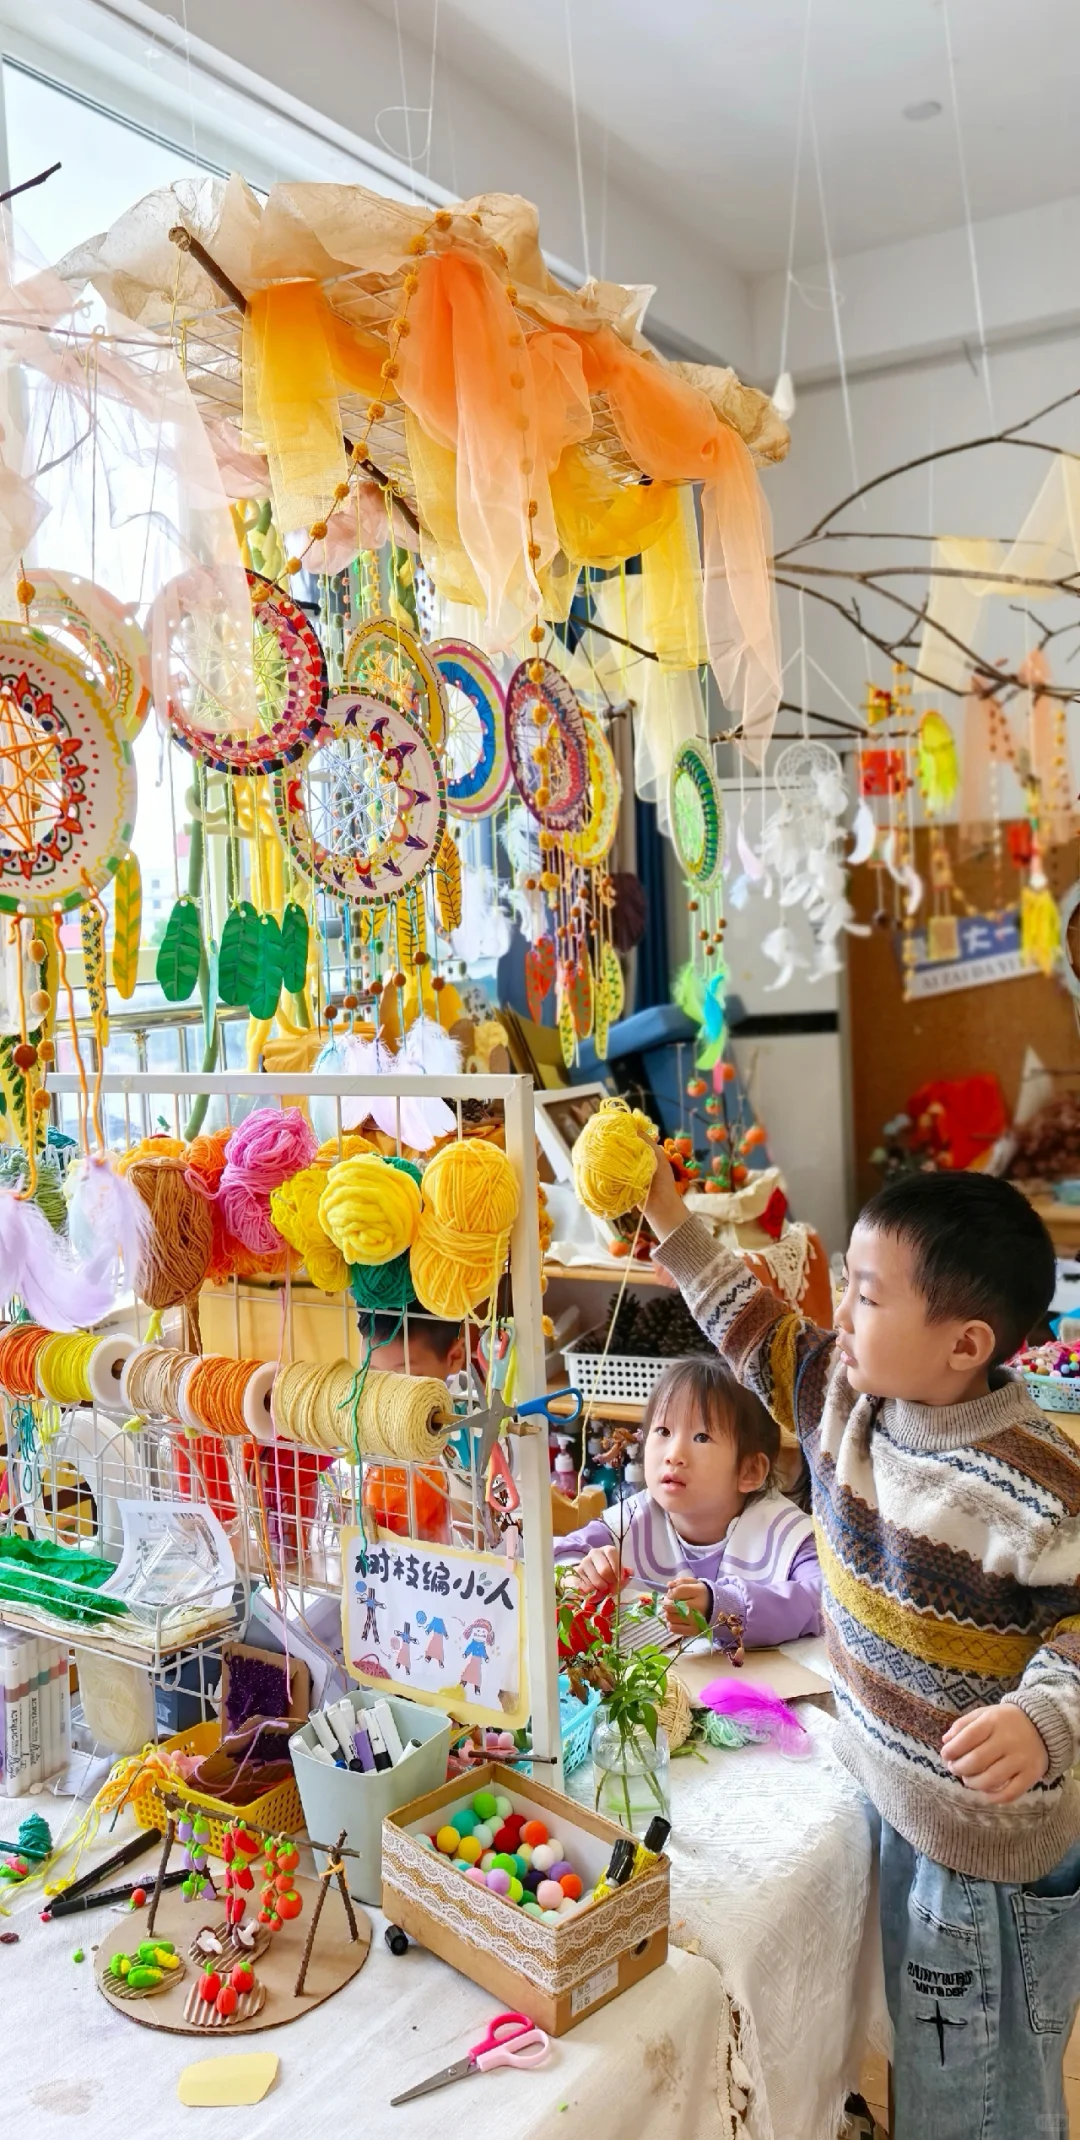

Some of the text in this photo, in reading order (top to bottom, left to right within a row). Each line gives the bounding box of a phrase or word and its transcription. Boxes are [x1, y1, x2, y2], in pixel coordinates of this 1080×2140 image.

[354, 1548, 514, 1610] 树枝编小人
